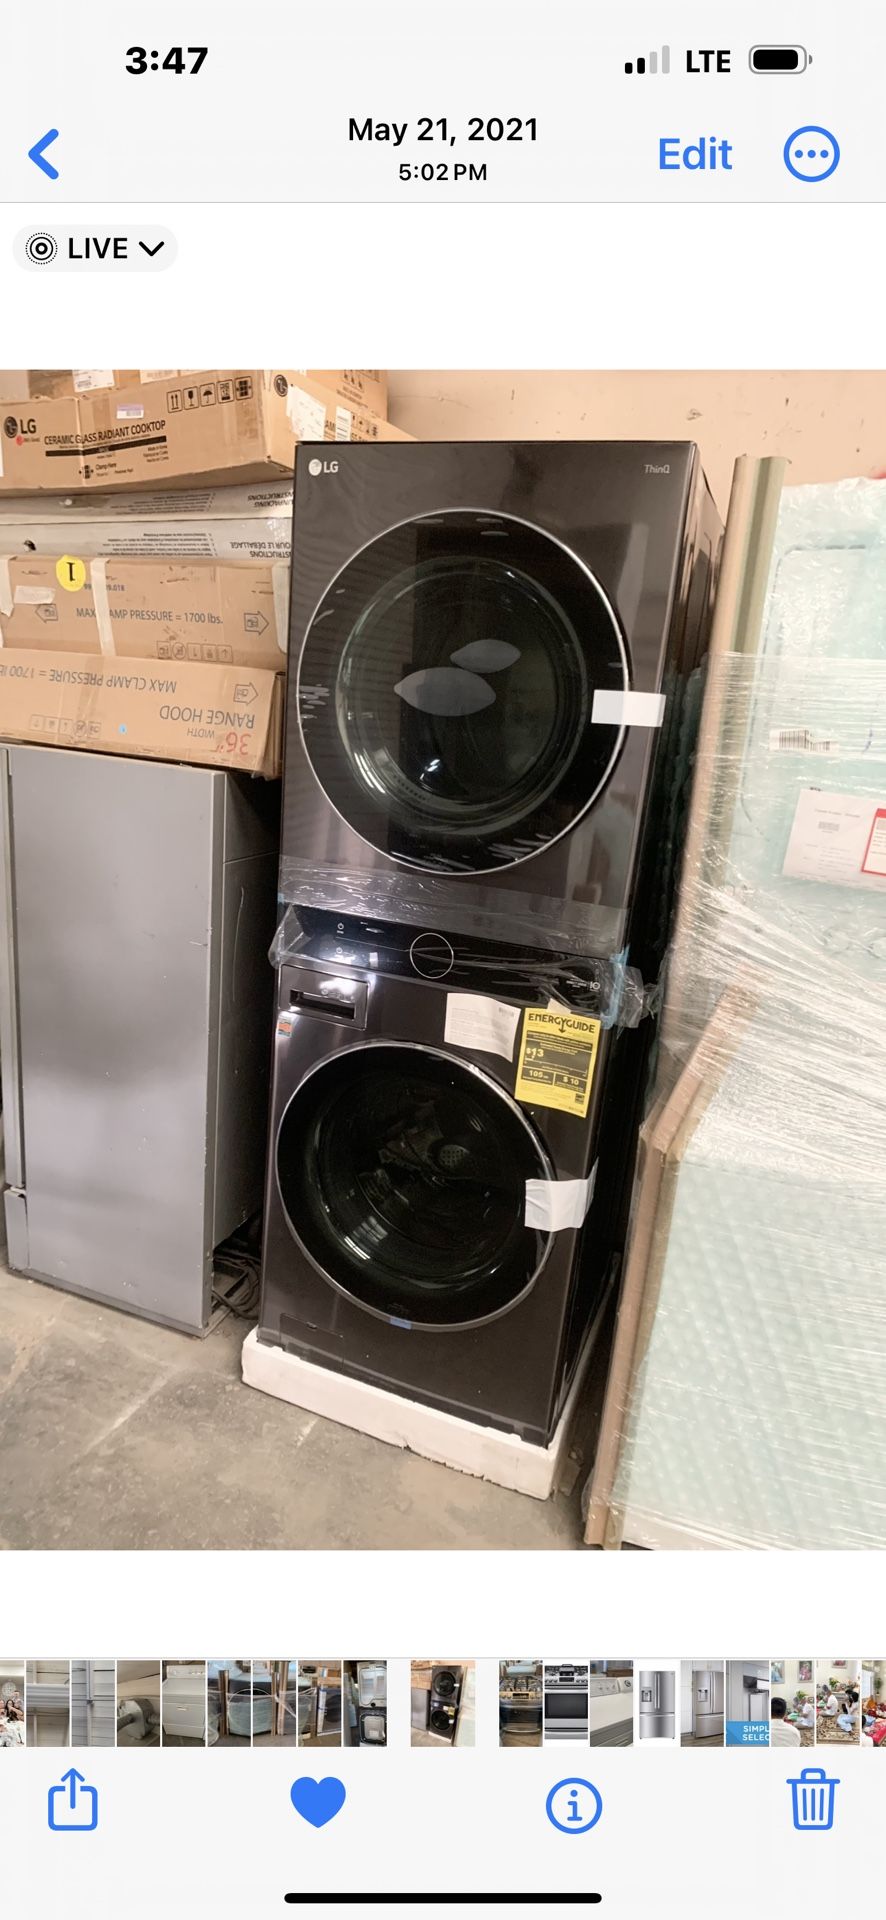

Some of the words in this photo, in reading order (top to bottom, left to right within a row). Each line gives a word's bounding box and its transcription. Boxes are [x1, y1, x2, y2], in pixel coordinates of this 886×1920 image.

[20, 418, 37, 434] LG
[44, 434, 74, 445] CERAMIC
[98, 426, 129, 441] RADIANT
[131, 420, 166, 436] COOKTOP
[323, 461, 339, 473] LG
[643, 464, 671, 474] ThinQ
[275, 542, 291, 550] OUR
[109, 608, 128, 620] AMP
[130, 609, 174, 621] PRESSURE
[184, 612, 206, 623] 1700
[207, 612, 224, 624] lbs.
[9, 665, 34, 679] 1700
[49, 668, 104, 687] PRESSURE
[106, 675, 147, 690] CLAMP
[150, 679, 177, 693] MAX
[159, 705, 203, 724] HOOD
[205, 709, 256, 729] RANGE
[186, 727, 215, 739] WIDTH
